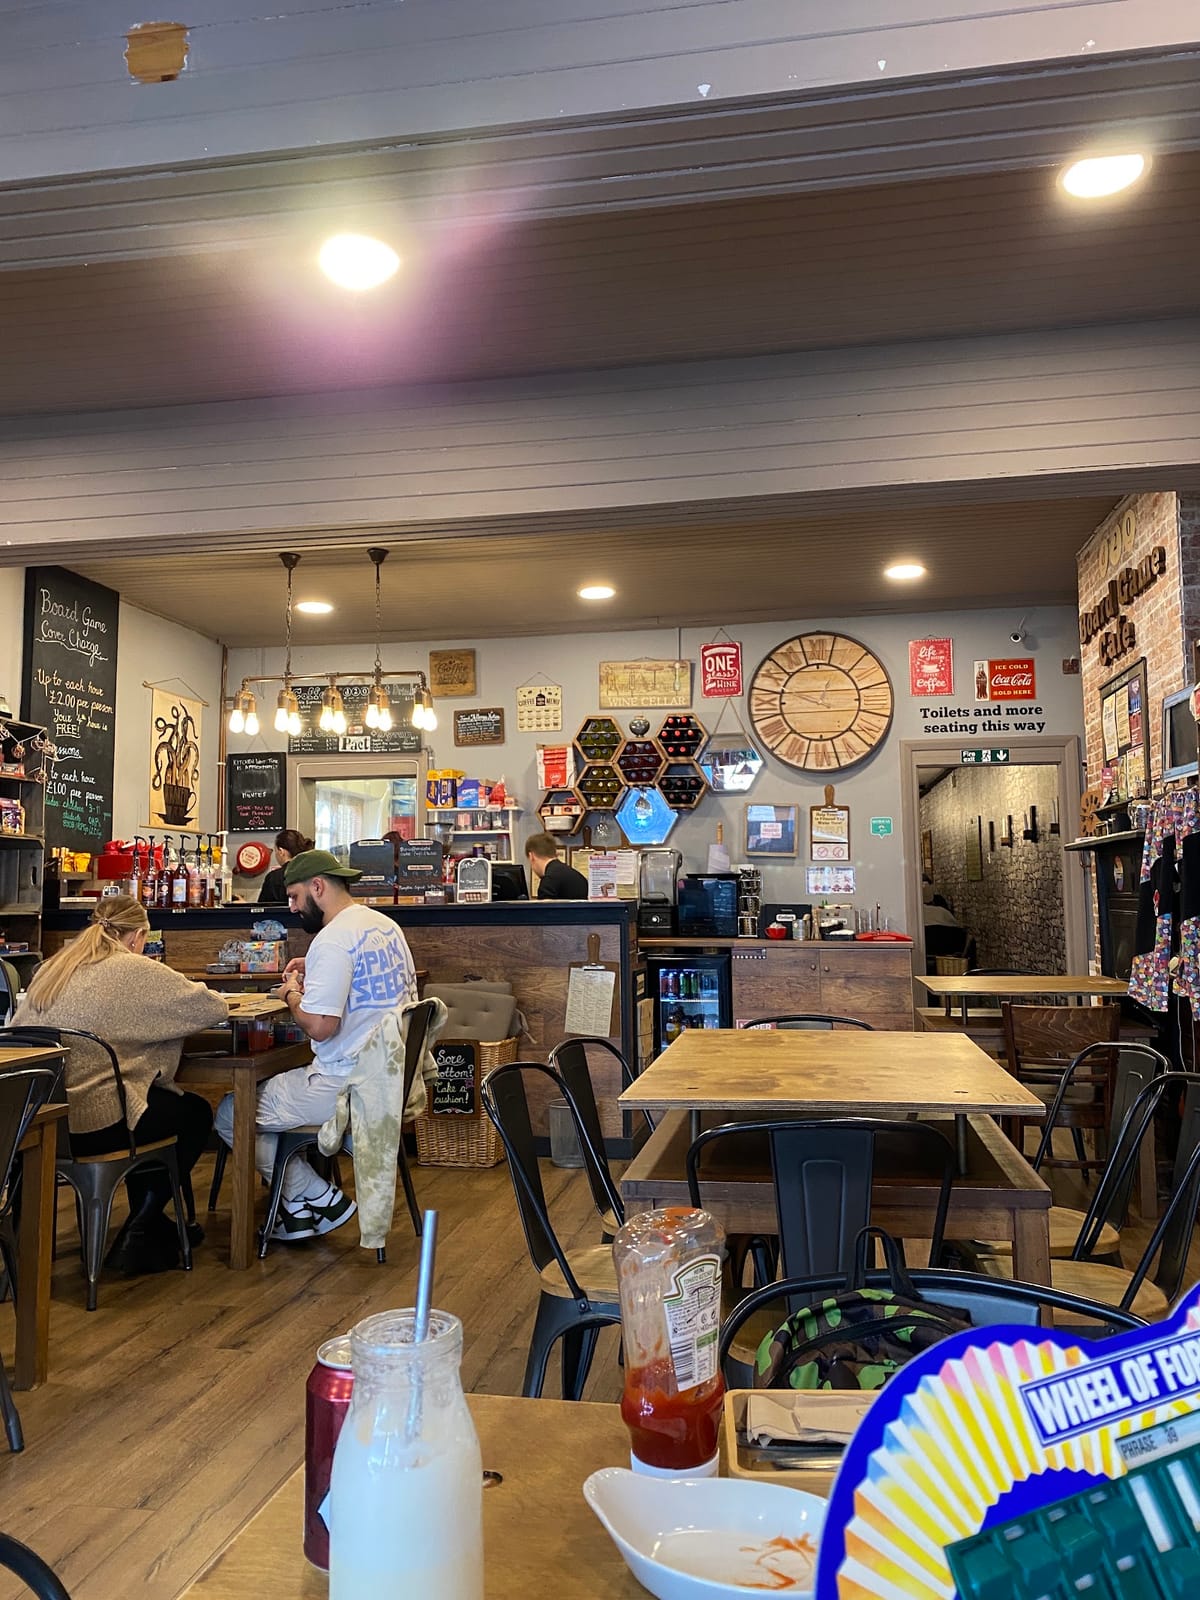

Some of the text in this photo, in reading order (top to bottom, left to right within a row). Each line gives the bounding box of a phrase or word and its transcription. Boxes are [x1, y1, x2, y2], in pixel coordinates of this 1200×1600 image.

[1079, 546, 1166, 644] Board Game
[40, 588, 107, 636] Board Game
[41, 620, 101, 667] Cover Charge
[919, 645, 937, 660] life
[705, 655, 735, 672] ONE
[38, 668, 104, 696] Up to each hour
[705, 668, 738, 684] glass
[991, 673, 1032, 686] Coca-Cola
[717, 680, 737, 688] WINE
[916, 678, 946, 692] coffee
[76, 699, 89, 715] per
[91, 701, 113, 717] person
[518, 697, 560, 706] COFFEE MENU
[608, 696, 686, 706] WINE CELLAR
[53, 709, 73, 722] Your
[86, 716, 101, 729] hour
[920, 705, 1043, 719] Toilets and more
[56, 723, 80, 735] FREE!
[924, 720, 1045, 734] seating this way
[341, 737, 369, 750] Pact
[51, 762, 96, 784] to each hour
[70, 789, 82, 803] per
[86, 791, 104, 806] person
[437, 1049, 465, 1065] Sore
[439, 1065, 474, 1078] ottom?
[435, 1081, 467, 1093] Take a
[434, 1093, 469, 1104] cushion!
[1027, 1366, 1132, 1435] WHEEL
[1121, 1354, 1159, 1403] OF
[1120, 1434, 1158, 1459] PHRASE
